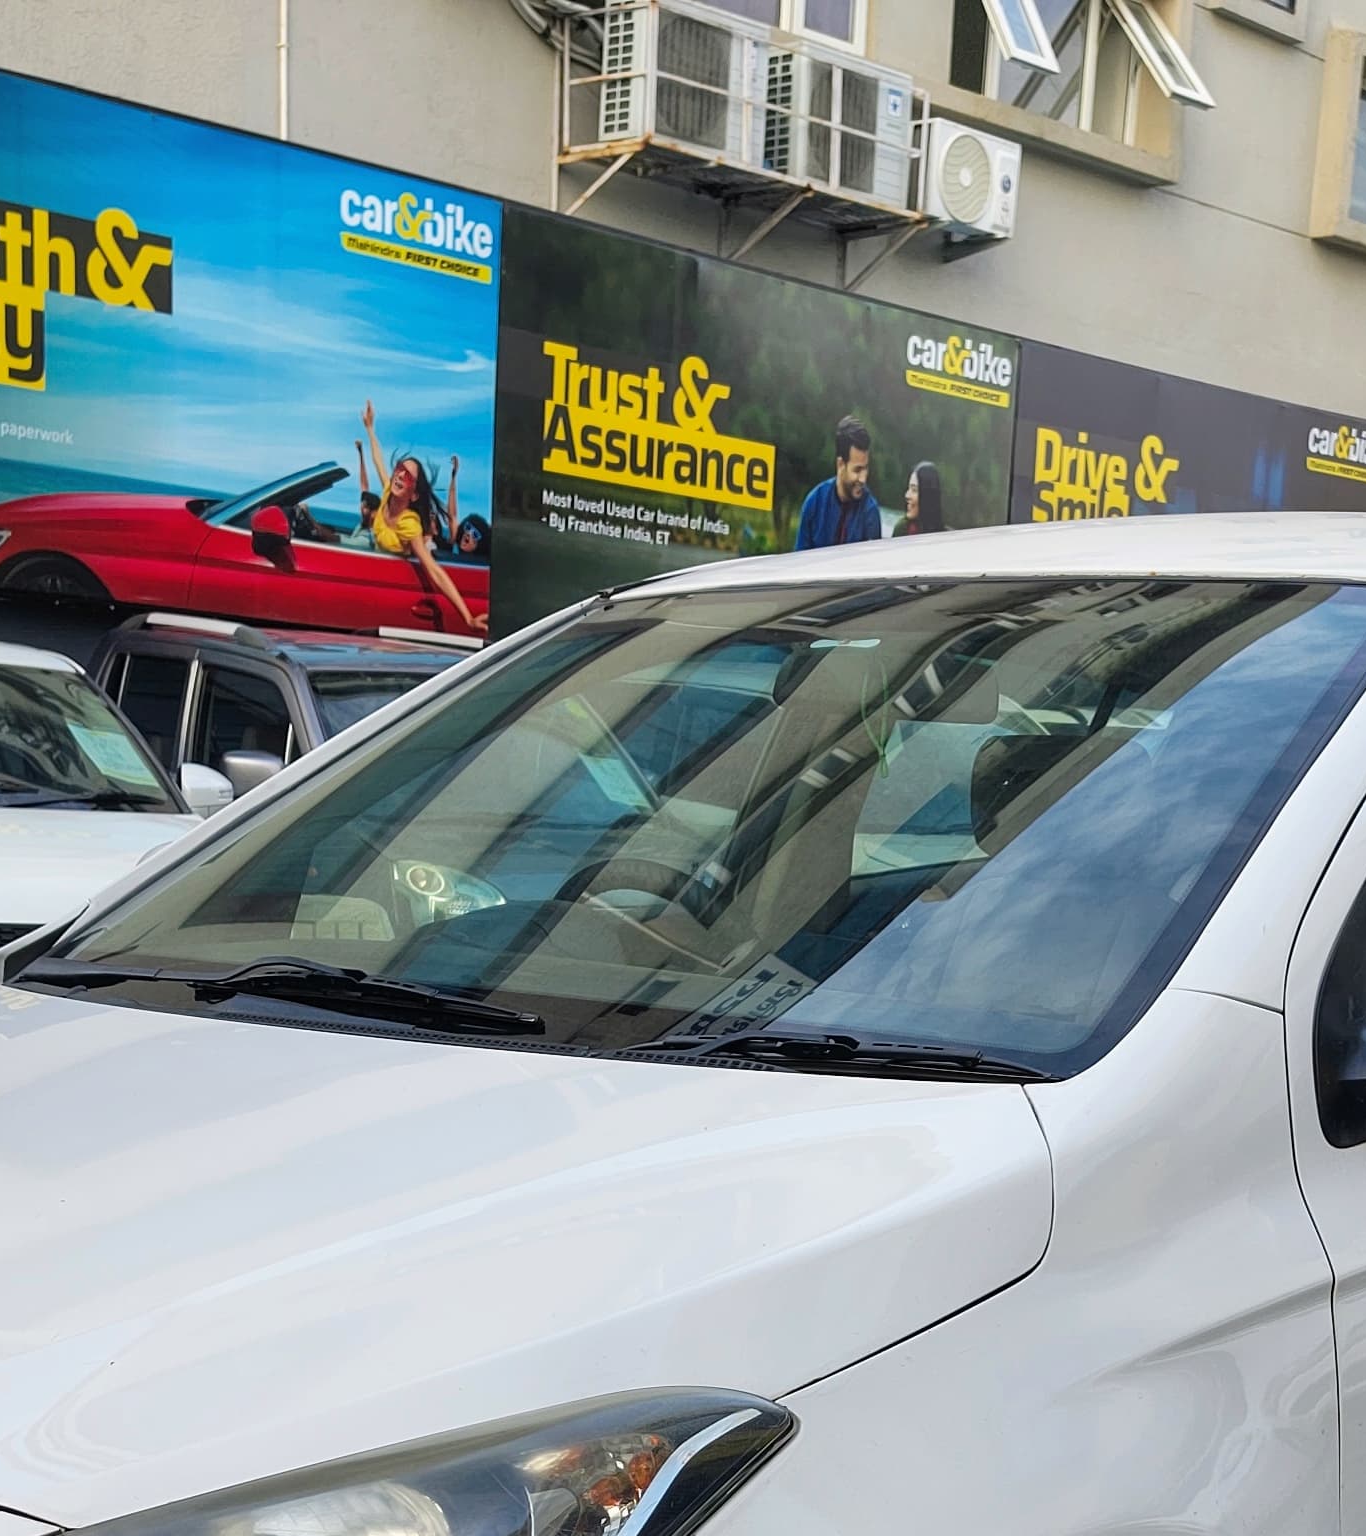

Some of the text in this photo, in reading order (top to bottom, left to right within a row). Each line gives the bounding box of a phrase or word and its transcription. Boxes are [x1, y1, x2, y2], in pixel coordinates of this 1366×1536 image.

[340, 189, 493, 259] car&bike
[87, 208, 173, 311] &
[405, 251, 437, 267] FIRST
[439, 259, 480, 277] CHOICE
[543, 340, 731, 433] Trust &
[906, 335, 1013, 387] car&bike
[0, 421, 74, 445] paperwork
[543, 405, 769, 499] Assurance
[1034, 427, 1180, 504] Drive &
[542, 488, 730, 535] Most loved Used Car brand of India
[1032, 481, 1129, 522] Smil
[549, 512, 566, 533] By
[567, 516, 621, 539] Franchise
[623, 524, 654, 546] India,
[656, 530, 671, 545] ET
